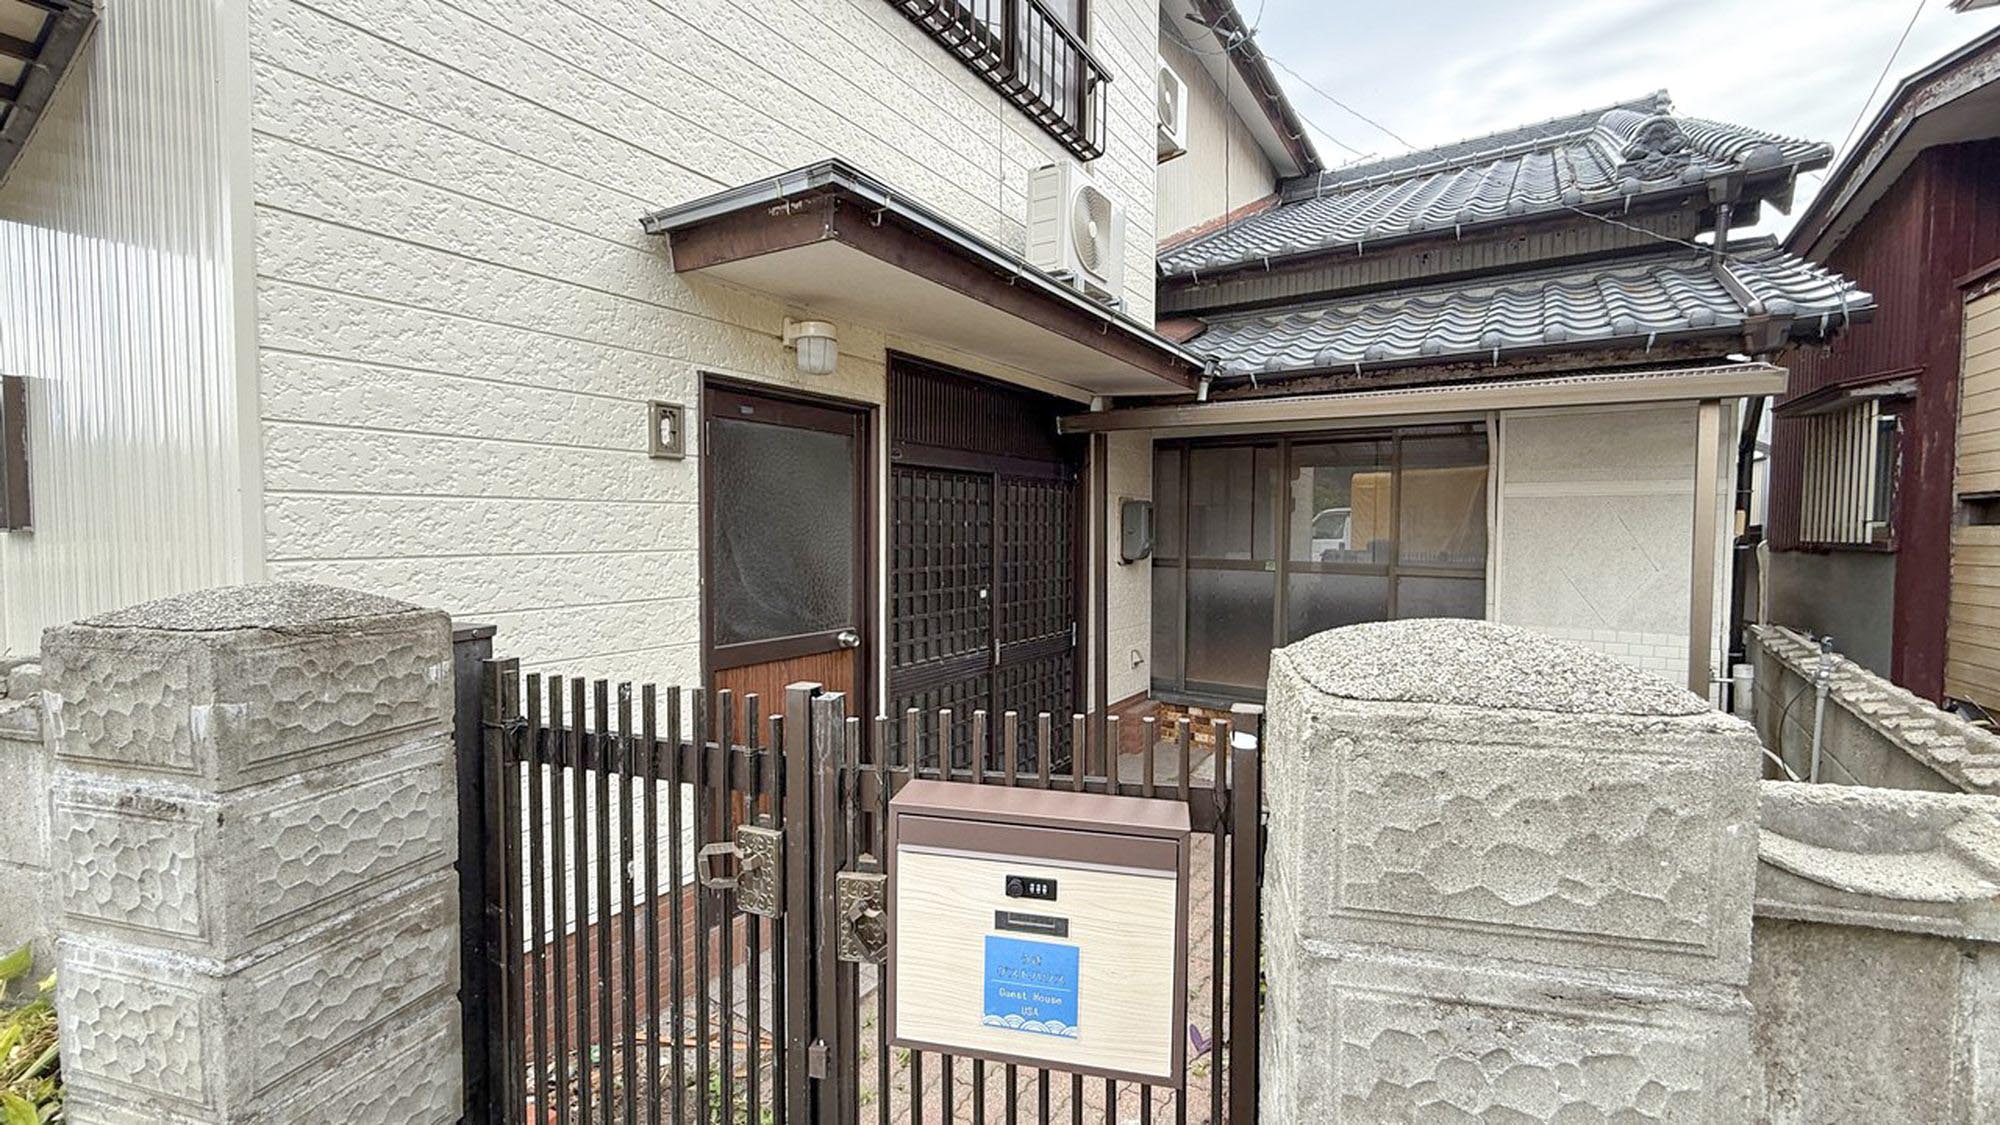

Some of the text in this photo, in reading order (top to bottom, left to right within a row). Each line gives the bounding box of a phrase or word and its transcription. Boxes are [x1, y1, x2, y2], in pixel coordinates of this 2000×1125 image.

[999, 987, 1062, 1005] Guest House
[1021, 1006, 1039, 1016] USA
